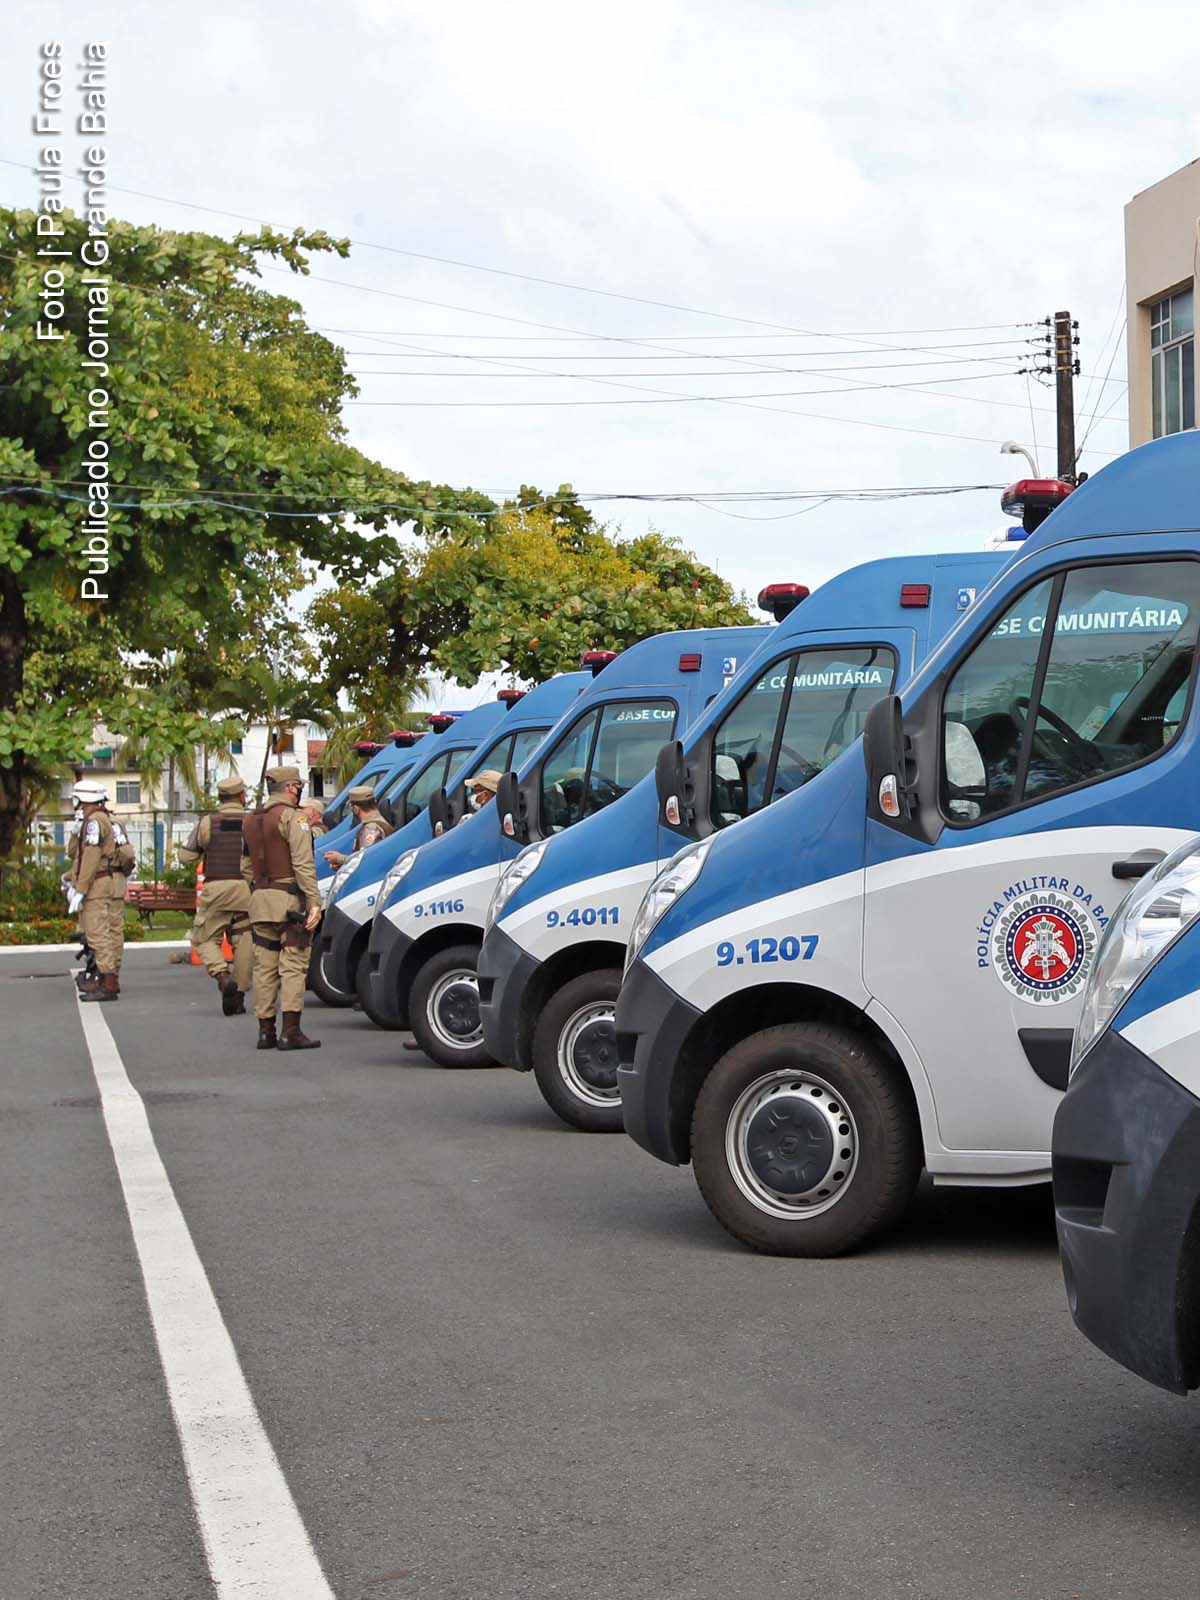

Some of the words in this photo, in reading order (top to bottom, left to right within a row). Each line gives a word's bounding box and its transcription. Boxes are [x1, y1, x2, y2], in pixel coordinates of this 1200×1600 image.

[1028, 606, 1184, 633] CMUNITÁRIA
[414, 898, 465, 918] 9.1116
[546, 906, 620, 929] 9.4011
[977, 900, 1005, 969] POLÍCIA
[1003, 876, 1070, 902] MILITAR
[1072, 885, 1094, 906] DA
[1092, 905, 1110, 932] BA
[716, 934, 820, 967] 9.1207
